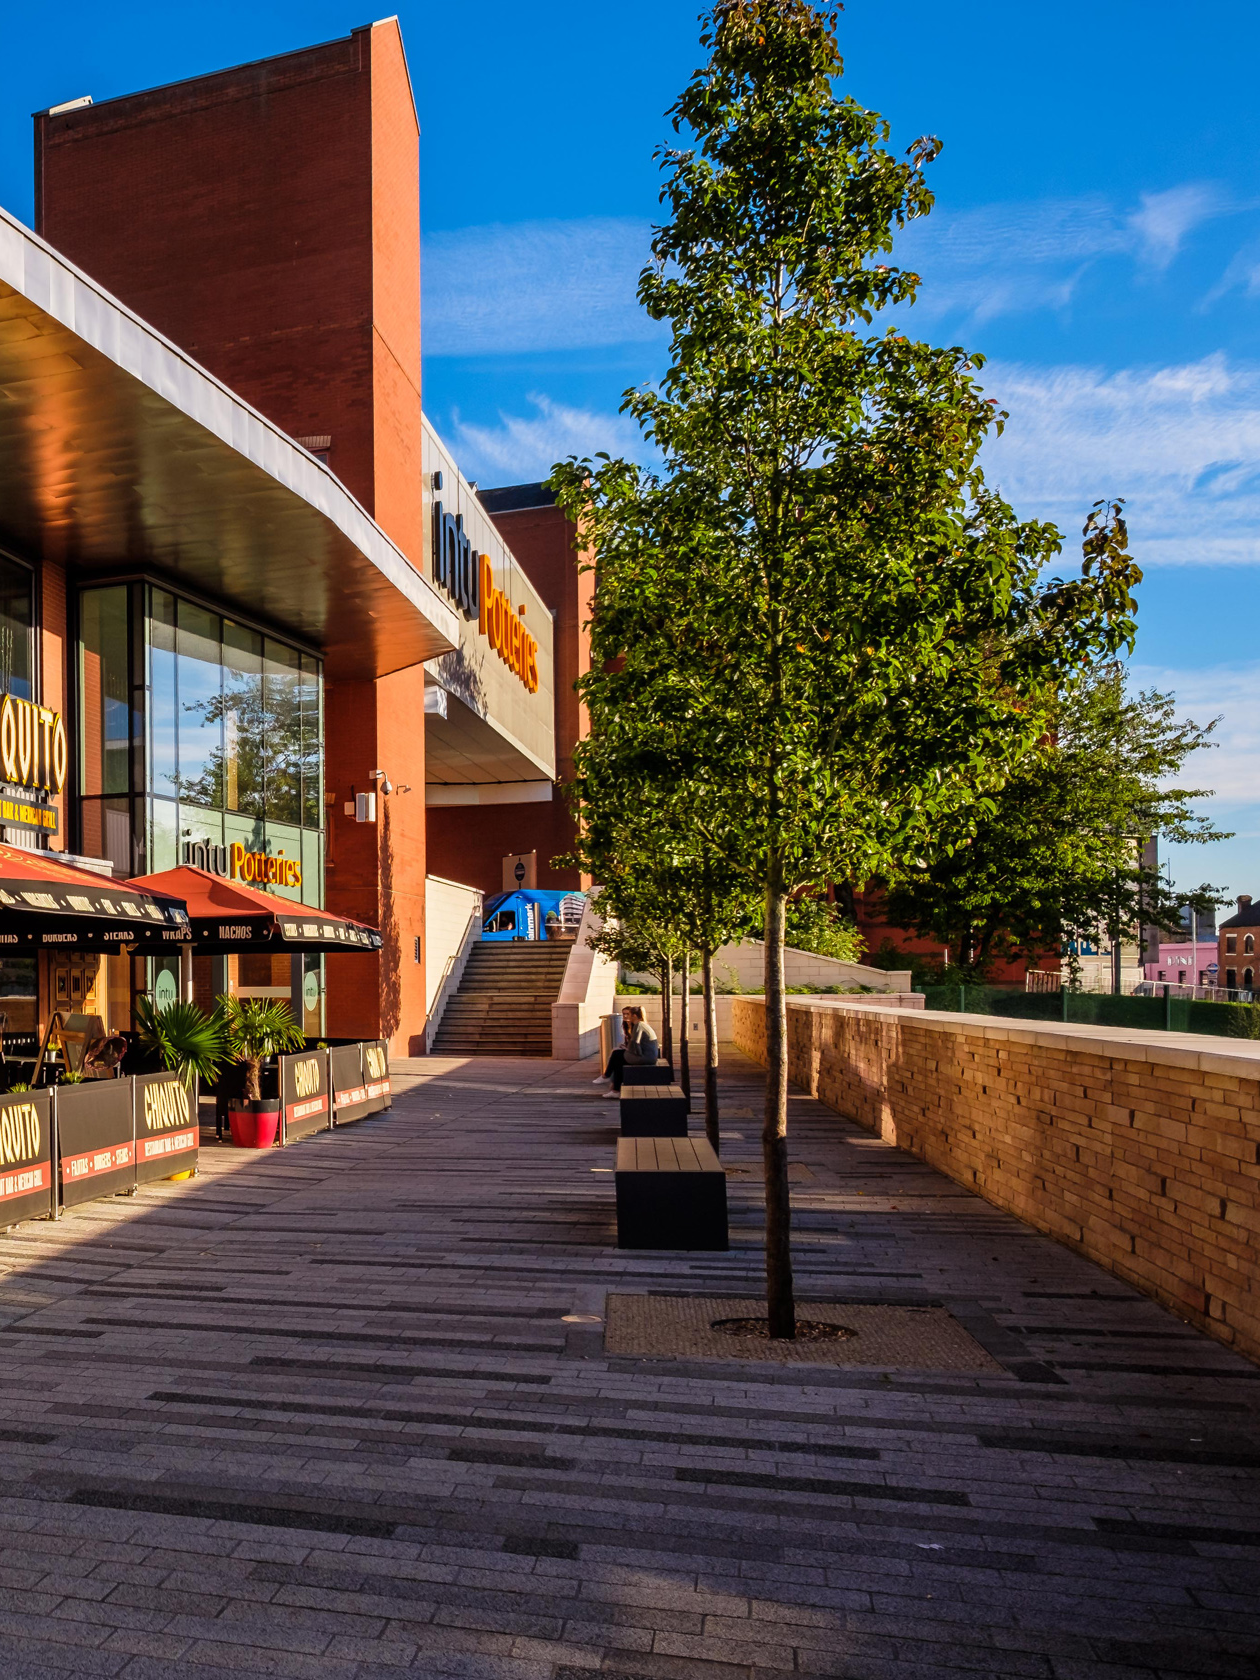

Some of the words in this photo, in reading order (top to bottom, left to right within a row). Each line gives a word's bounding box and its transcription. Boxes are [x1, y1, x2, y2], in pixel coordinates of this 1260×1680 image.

[434, 470, 479, 622] intu
[479, 553, 538, 694] Potteries
[3, 800, 14, 821] BAR
[14, 804, 19, 821] &
[19, 804, 42, 826] MEXICAN
[42, 808, 57, 829] GRILL
[185, 829, 228, 877] intu
[230, 842, 302, 888] Potteries
[162, 926, 193, 940] WRAPS
[219, 925, 253, 940] NACHOS
[524, 903, 535, 940] ainmark
[158, 985, 174, 1000] intu
[144, 1080, 190, 1130] CHIQUITO
